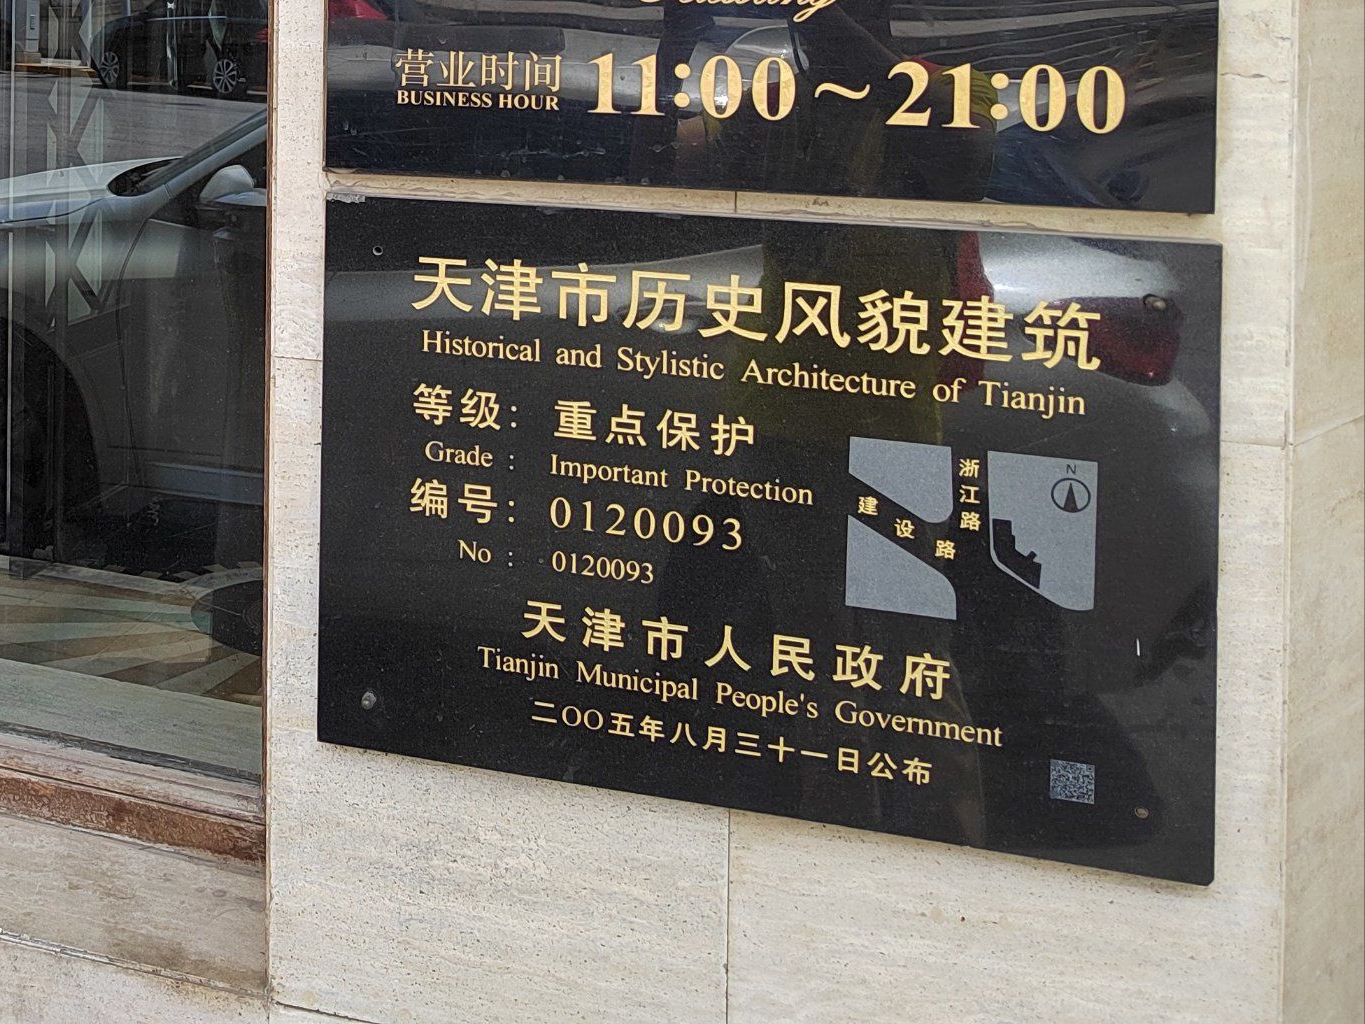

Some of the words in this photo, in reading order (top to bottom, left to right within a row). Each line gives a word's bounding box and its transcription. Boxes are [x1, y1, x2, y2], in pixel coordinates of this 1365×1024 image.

[395, 48, 561, 94] 营业时间
[396, 90, 494, 108] BUSINESS
[498, 94, 559, 111] HOUR
[411, 255, 1103, 372] 天津市历史风貌建筑
[421, 330, 542, 364] Historical
[556, 344, 603, 371] and
[617, 347, 725, 382] Stylistic
[741, 360, 916, 401] Architecture
[932, 376, 962, 404] of
[979, 379, 1087, 418] Tianjin
[553, 400, 756, 458] 重点保护
[424, 441, 493, 470] Grade
[550, 454, 669, 492] Important
[685, 468, 814, 506] Protection
[959, 458, 981, 531] 浙江路
[549, 499, 745, 553] 0120093
[857, 496, 956, 560] 建设路
[458, 539, 492, 564] No
[550, 550, 655, 585] 0120093
[522, 599, 953, 701] 天津市人民政府
[477, 646, 559, 681] Tianjin
[576, 661, 699, 701] Municipal
[715, 682, 819, 719] People's
[835, 700, 1003, 748] Government
